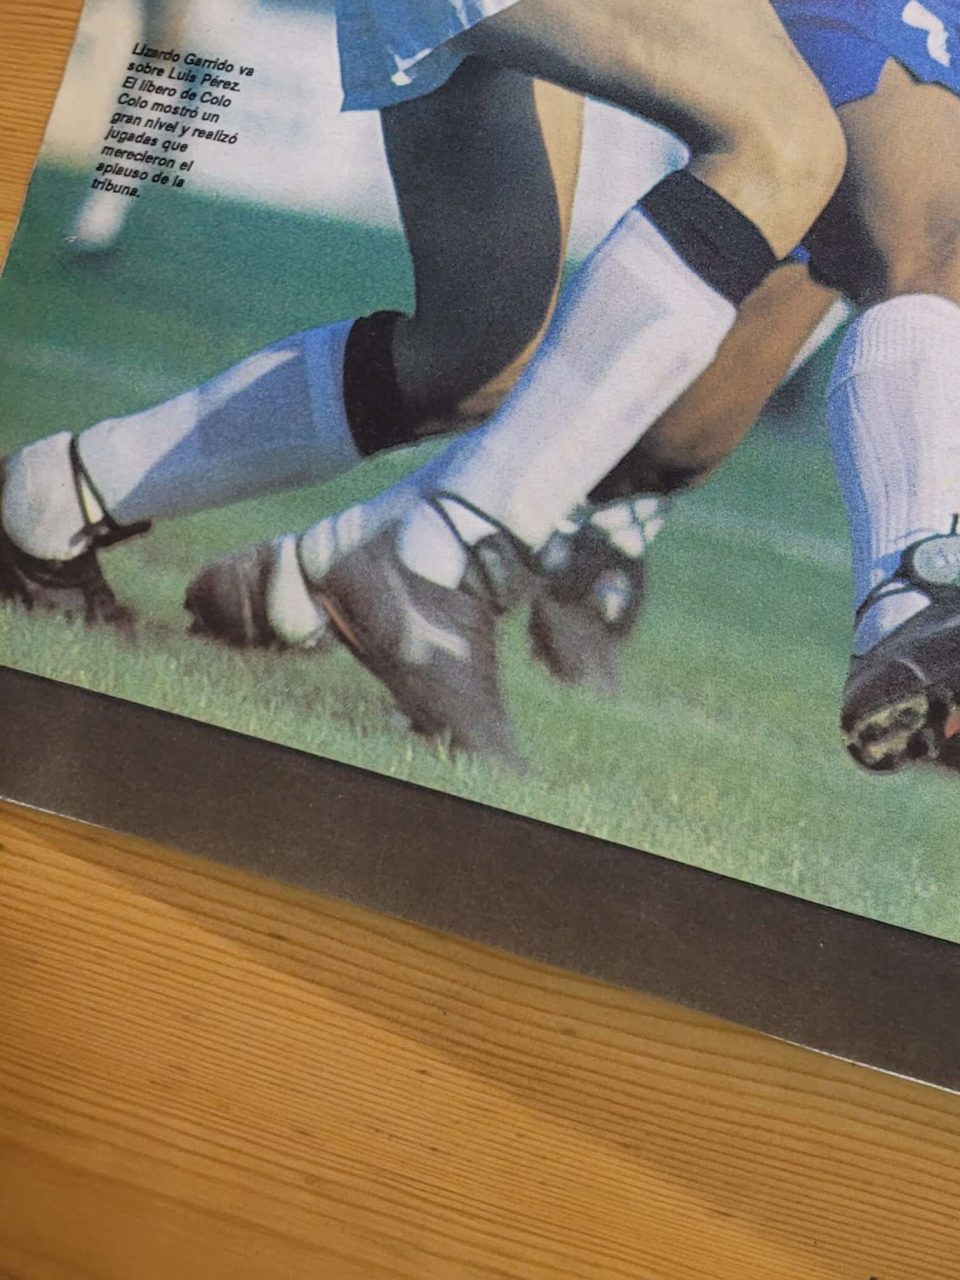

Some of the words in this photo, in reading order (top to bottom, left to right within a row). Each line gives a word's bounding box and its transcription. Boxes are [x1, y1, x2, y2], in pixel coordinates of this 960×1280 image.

[132, 43, 180, 61] Lizardo
[184, 53, 233, 71] Garrido
[239, 66, 253, 75] va
[122, 76, 137, 88] El
[139, 80, 176, 96] líbero
[180, 88, 196, 100] de
[200, 91, 230, 106] Colo
[127, 62, 164, 76] sobre
[168, 67, 196, 82] Luis
[200, 73, 239, 91] Pérez.
[118, 92, 147, 108] Colo
[151, 102, 198, 117] mostró
[201, 112, 218, 122] un
[104, 126, 157, 145] jugadas
[162, 140, 187, 151] que
[110, 112, 141, 125] gran
[144, 118, 178, 132] nivel
[191, 128, 236, 143] realizó
[101, 146, 174, 168] merecieron
[179, 161, 193, 170] el
[91, 178, 139, 197] tribuna.
[95, 163, 147, 179] aplauso
[151, 171, 168, 184] de
[172, 175, 184, 187] la
